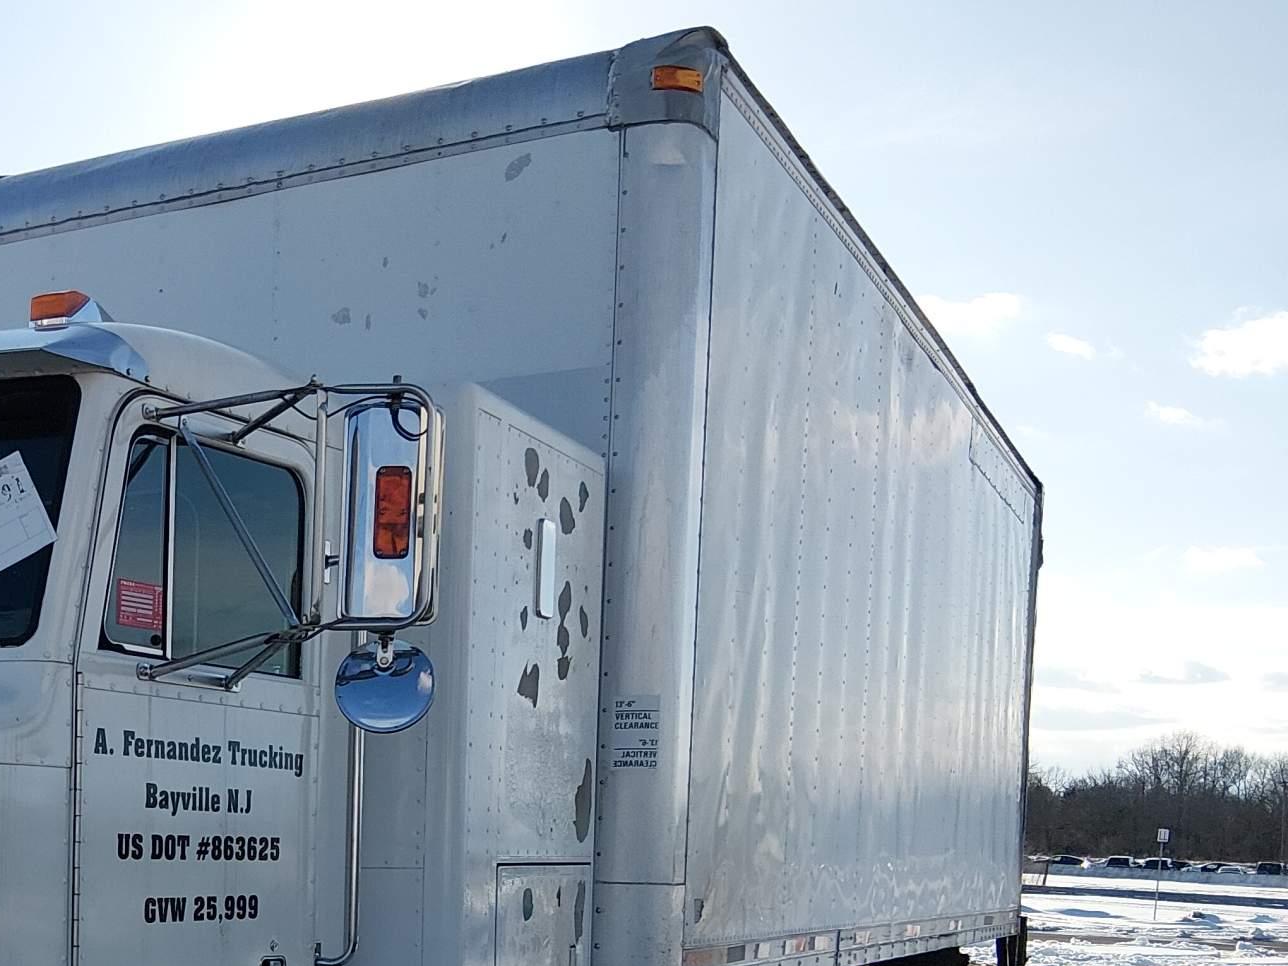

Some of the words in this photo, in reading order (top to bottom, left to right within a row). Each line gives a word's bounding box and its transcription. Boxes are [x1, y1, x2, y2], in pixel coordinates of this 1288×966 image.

[615, 712, 652, 720] VERTICAL
[93, 727, 114, 755] A.
[122, 729, 222, 764] Fernandez
[228, 740, 304, 778] Trucking
[144, 782, 221, 816] Bayville
[227, 788, 253, 814] N.J
[117, 833, 144, 860] US
[150, 834, 190, 861] DOT
[196, 835, 281, 861] #863625
[144, 896, 187, 924] GVW
[193, 894, 259, 924] 25,999
